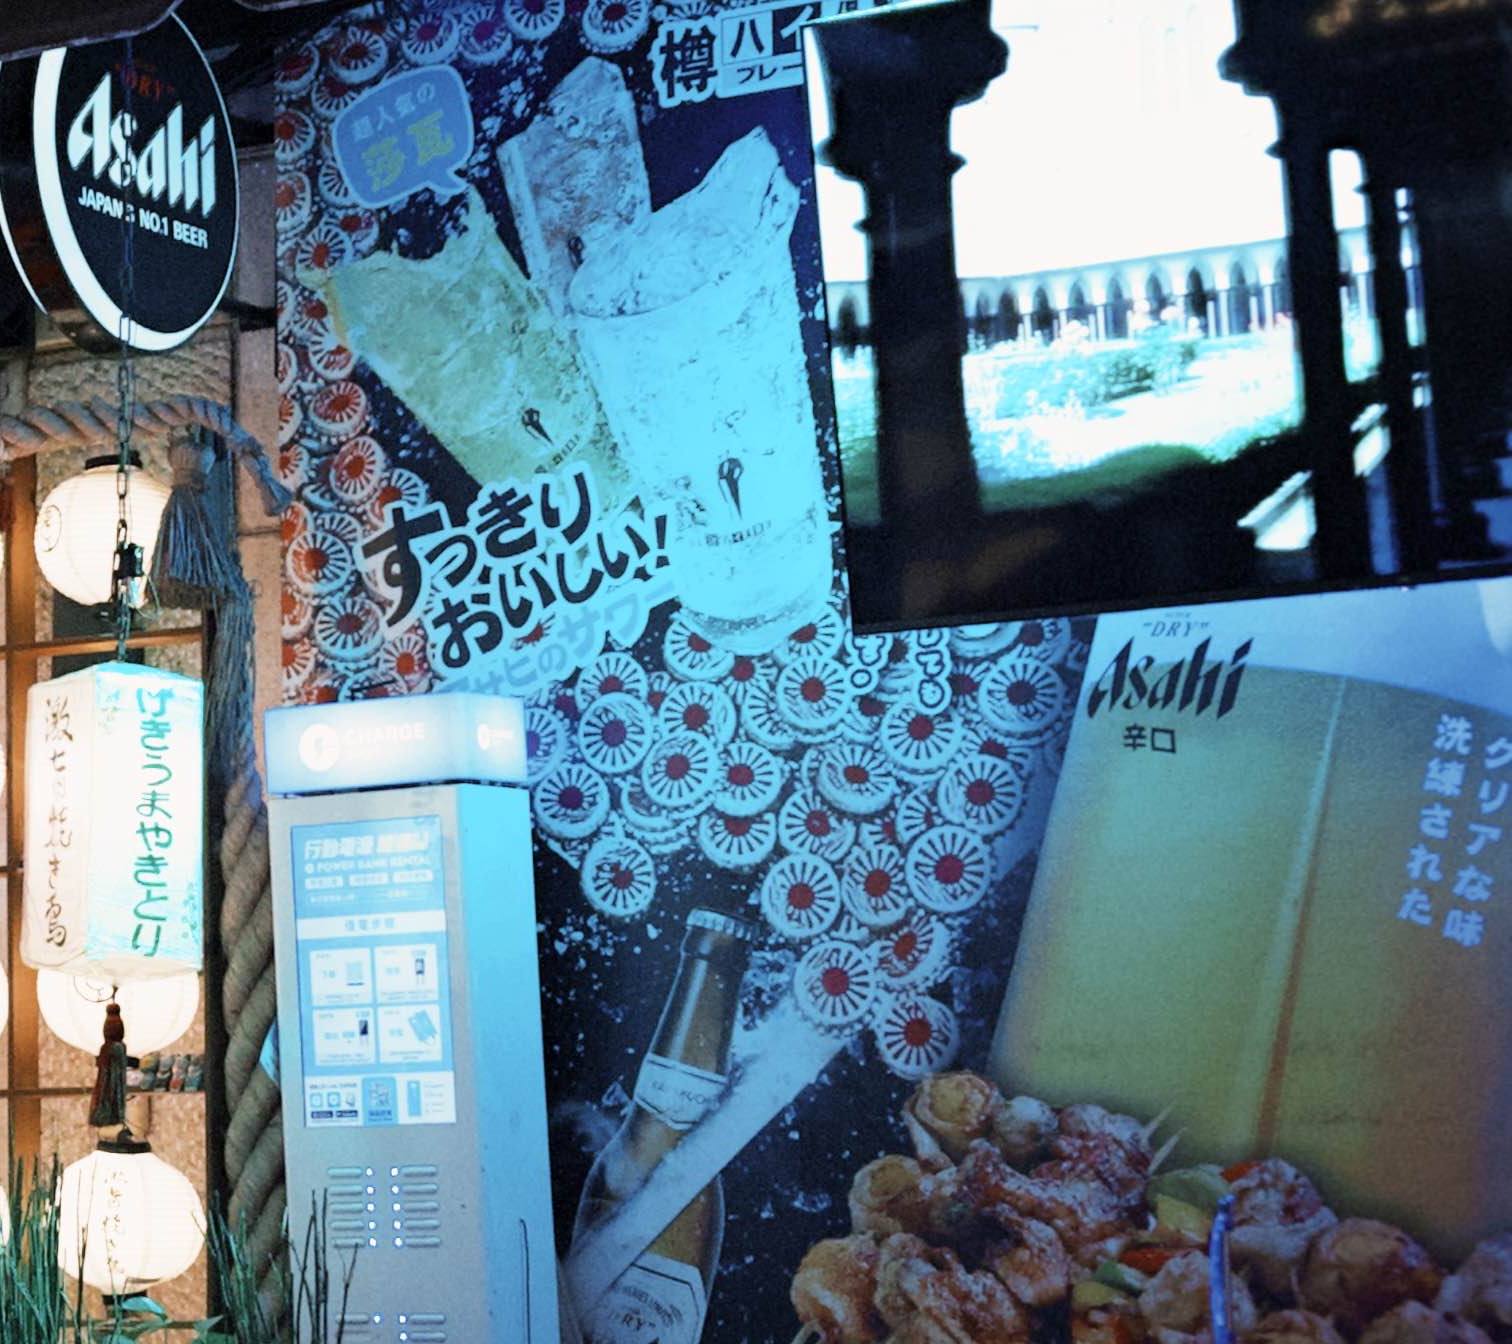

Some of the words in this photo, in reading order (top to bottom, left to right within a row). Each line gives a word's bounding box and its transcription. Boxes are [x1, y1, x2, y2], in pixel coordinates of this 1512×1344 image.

[67, 71, 216, 218] Asahi
[139, 208, 168, 236] NO.1
[173, 220, 209, 249] BEER
[362, 472, 592, 632] すっきり
[1088, 636, 1254, 720] Asahi
[1123, 723, 1177, 754] 辛口
[1398, 713, 1473, 928] 洗練された
[1443, 734, 1512, 949] クリアな味
